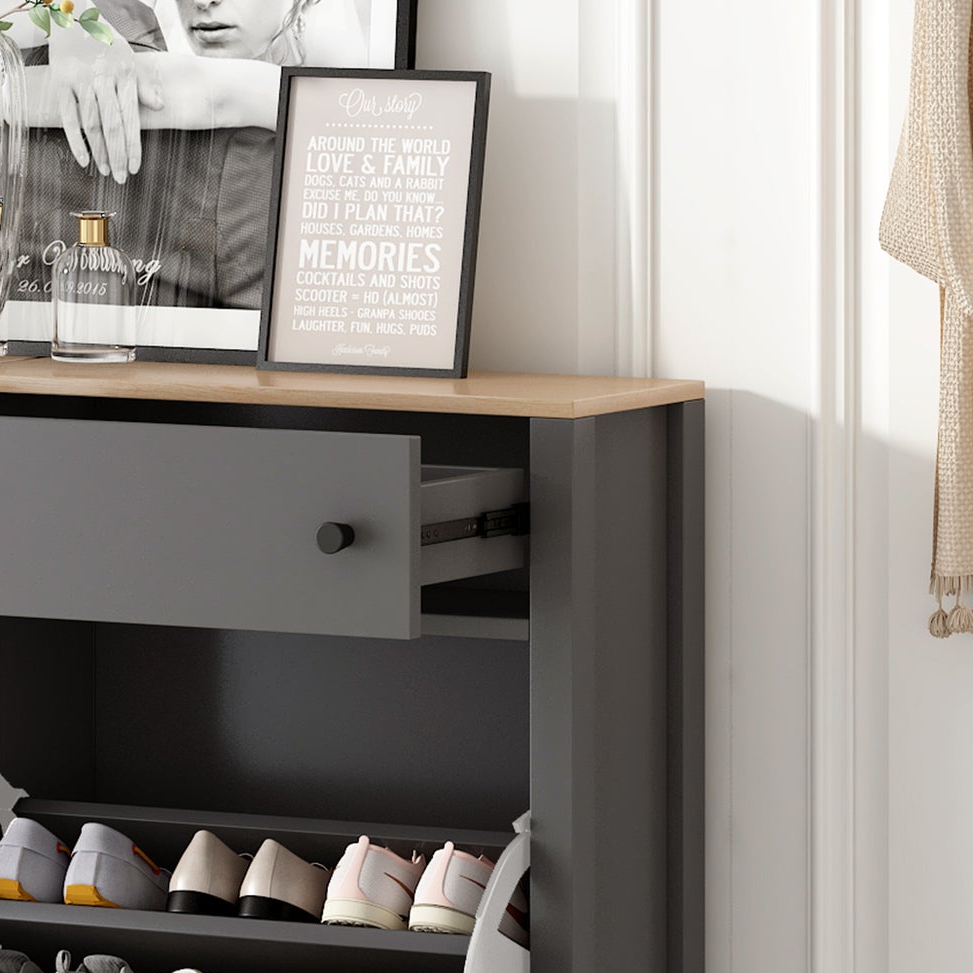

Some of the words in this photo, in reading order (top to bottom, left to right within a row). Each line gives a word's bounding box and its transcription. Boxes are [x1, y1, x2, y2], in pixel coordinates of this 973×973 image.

[339, 89, 382, 117] Our
[384, 93, 422, 119] story
[307, 136, 365, 151] AROUND
[370, 137, 396, 153] THE
[401, 138, 451, 154] WORLD
[306, 152, 354, 173] LOVE
[361, 154, 375, 174] &
[383, 155, 450, 176] FAMILY
[339, 176, 366, 187] CATS
[369, 177, 391, 188] AND
[394, 178, 402, 189] A
[405, 178, 445, 190] RABBIT
[303, 189, 341, 200] EXCUSE
[364, 191, 378, 201] DO
[381, 192, 403, 202] YOU
[302, 202, 328, 219] DID
[333, 203, 339, 219] I
[344, 204, 388, 221] PLAN
[393, 205, 445, 223] THAT?
[406, 226, 444, 239] HOMES
[298, 239, 441, 273] MEMORIES
[296, 271, 366, 287] COCKTAILS
[369, 274, 396, 287] AND
[400, 276, 441, 290] SHOTS
[294, 289, 347, 302] SCOOTER
[363, 291, 379, 304] HD
[382, 292, 438, 308] (ALMOST)
[293, 305, 315, 316] HIGH
[318, 306, 348, 318] HEELS
[357, 308, 395, 319] GRANPA
[398, 310, 436, 321] SHOOES
[409, 324, 437, 336] PUDS
